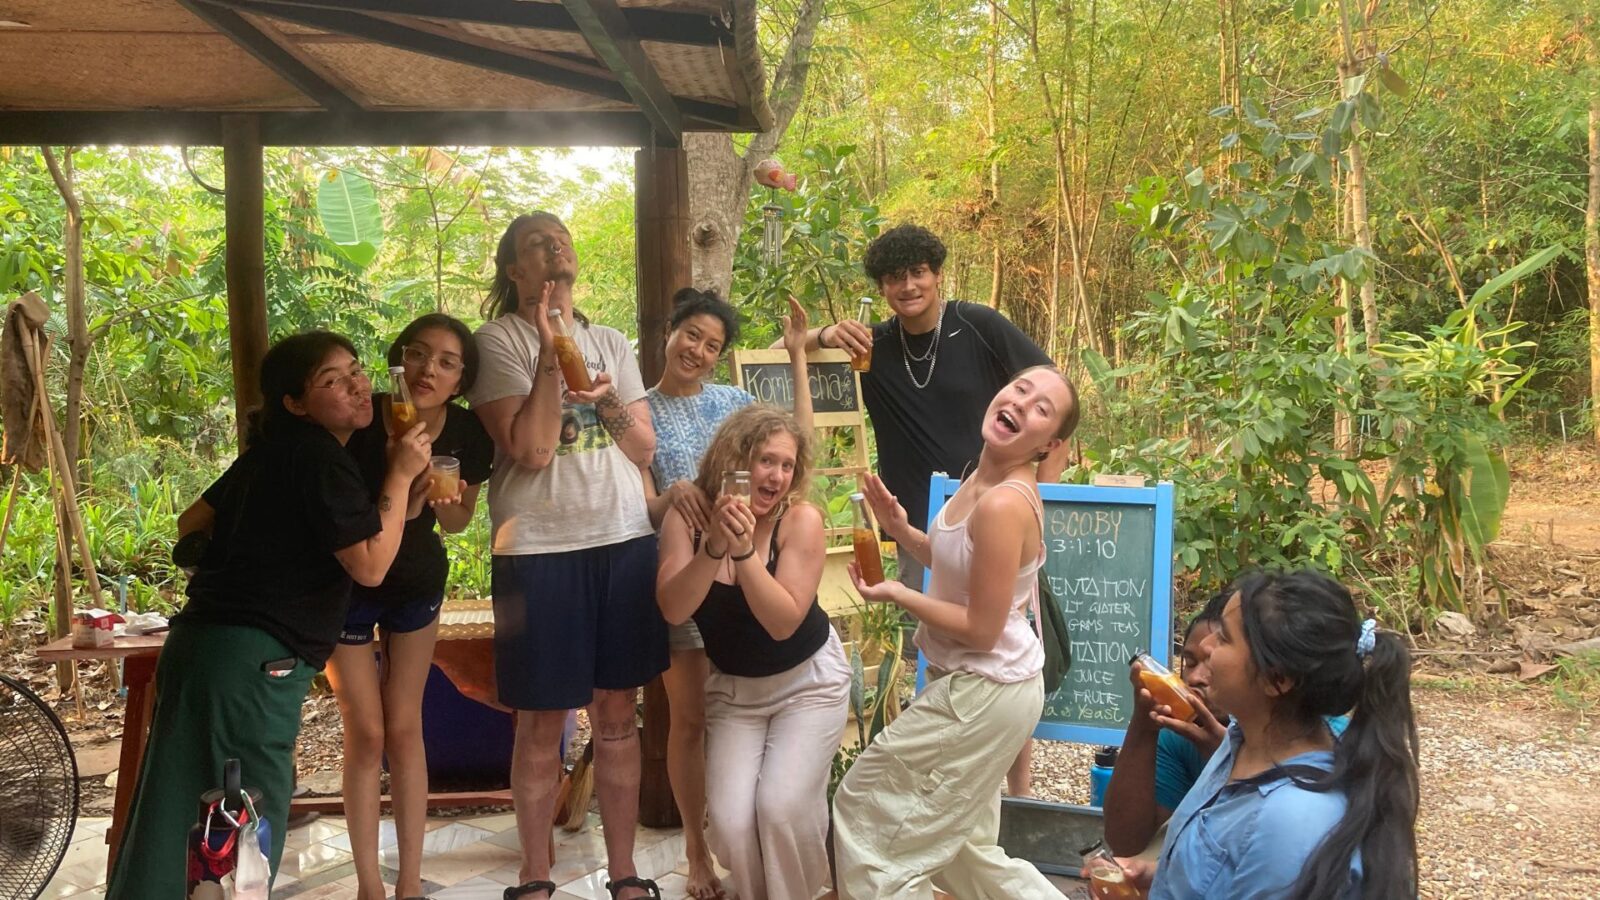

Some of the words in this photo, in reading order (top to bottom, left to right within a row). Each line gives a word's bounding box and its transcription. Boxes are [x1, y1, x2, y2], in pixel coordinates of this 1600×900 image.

[745, 367, 844, 403] Kombcha
[1051, 509, 1122, 544] SCOBY
[1052, 537, 1116, 559] 3:1:10
[1047, 575, 1147, 598] ENTATION
[1110, 621, 1140, 637] TEAS
[1070, 640, 1139, 664] TATION
[1074, 669, 1115, 685] JUICE
[1078, 704, 1125, 722] Yeast
